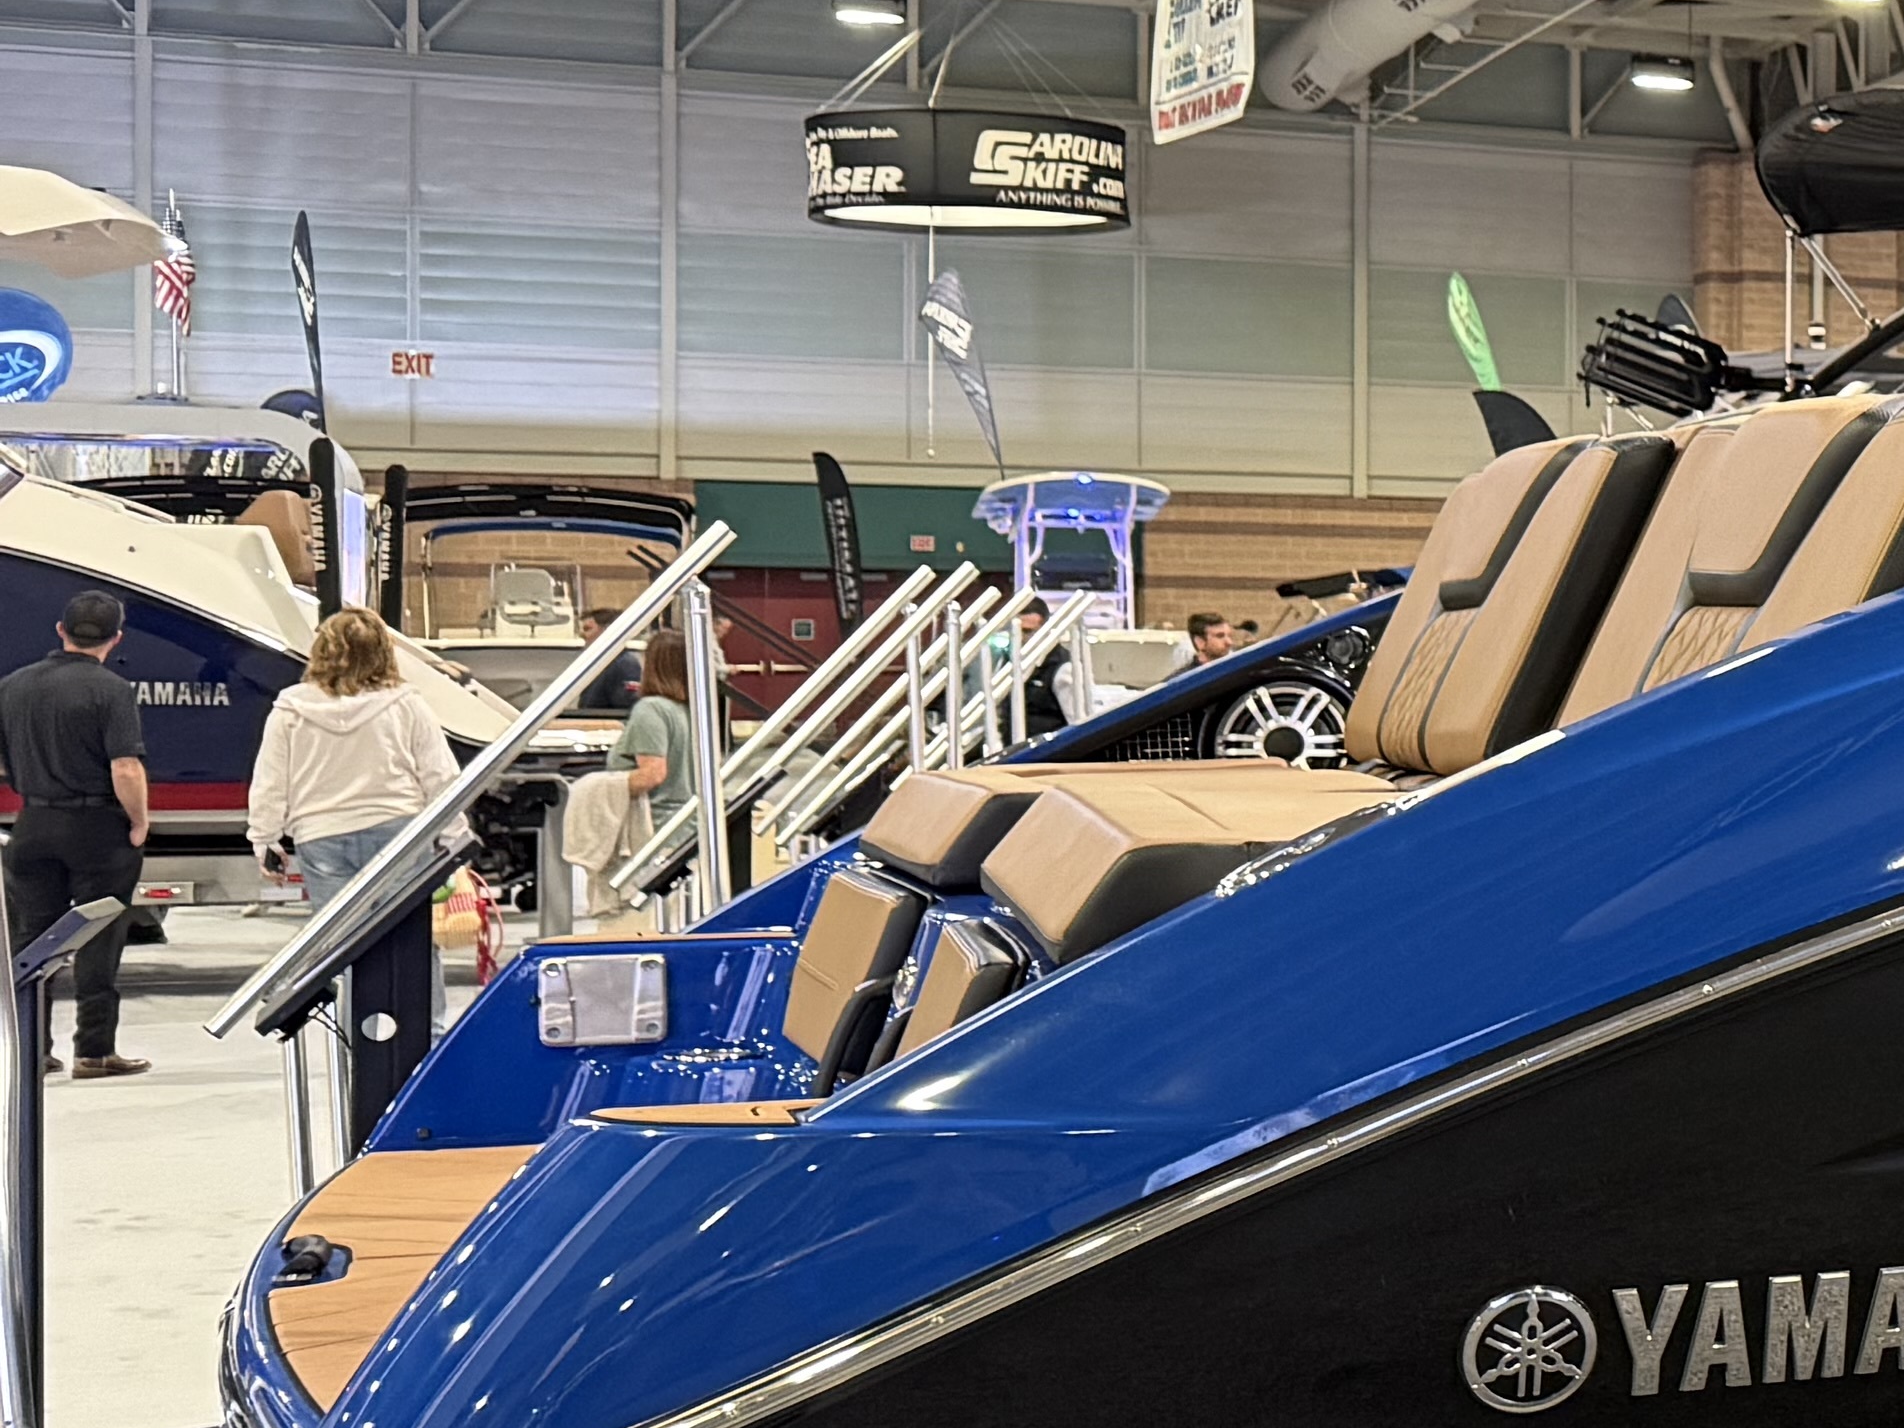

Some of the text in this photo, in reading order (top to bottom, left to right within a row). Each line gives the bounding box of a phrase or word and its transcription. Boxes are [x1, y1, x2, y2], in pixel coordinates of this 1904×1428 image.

[996, 189, 1072, 208] ANYTHING
[392, 352, 434, 377] EXIT
[130, 681, 230, 706] AMAHA
